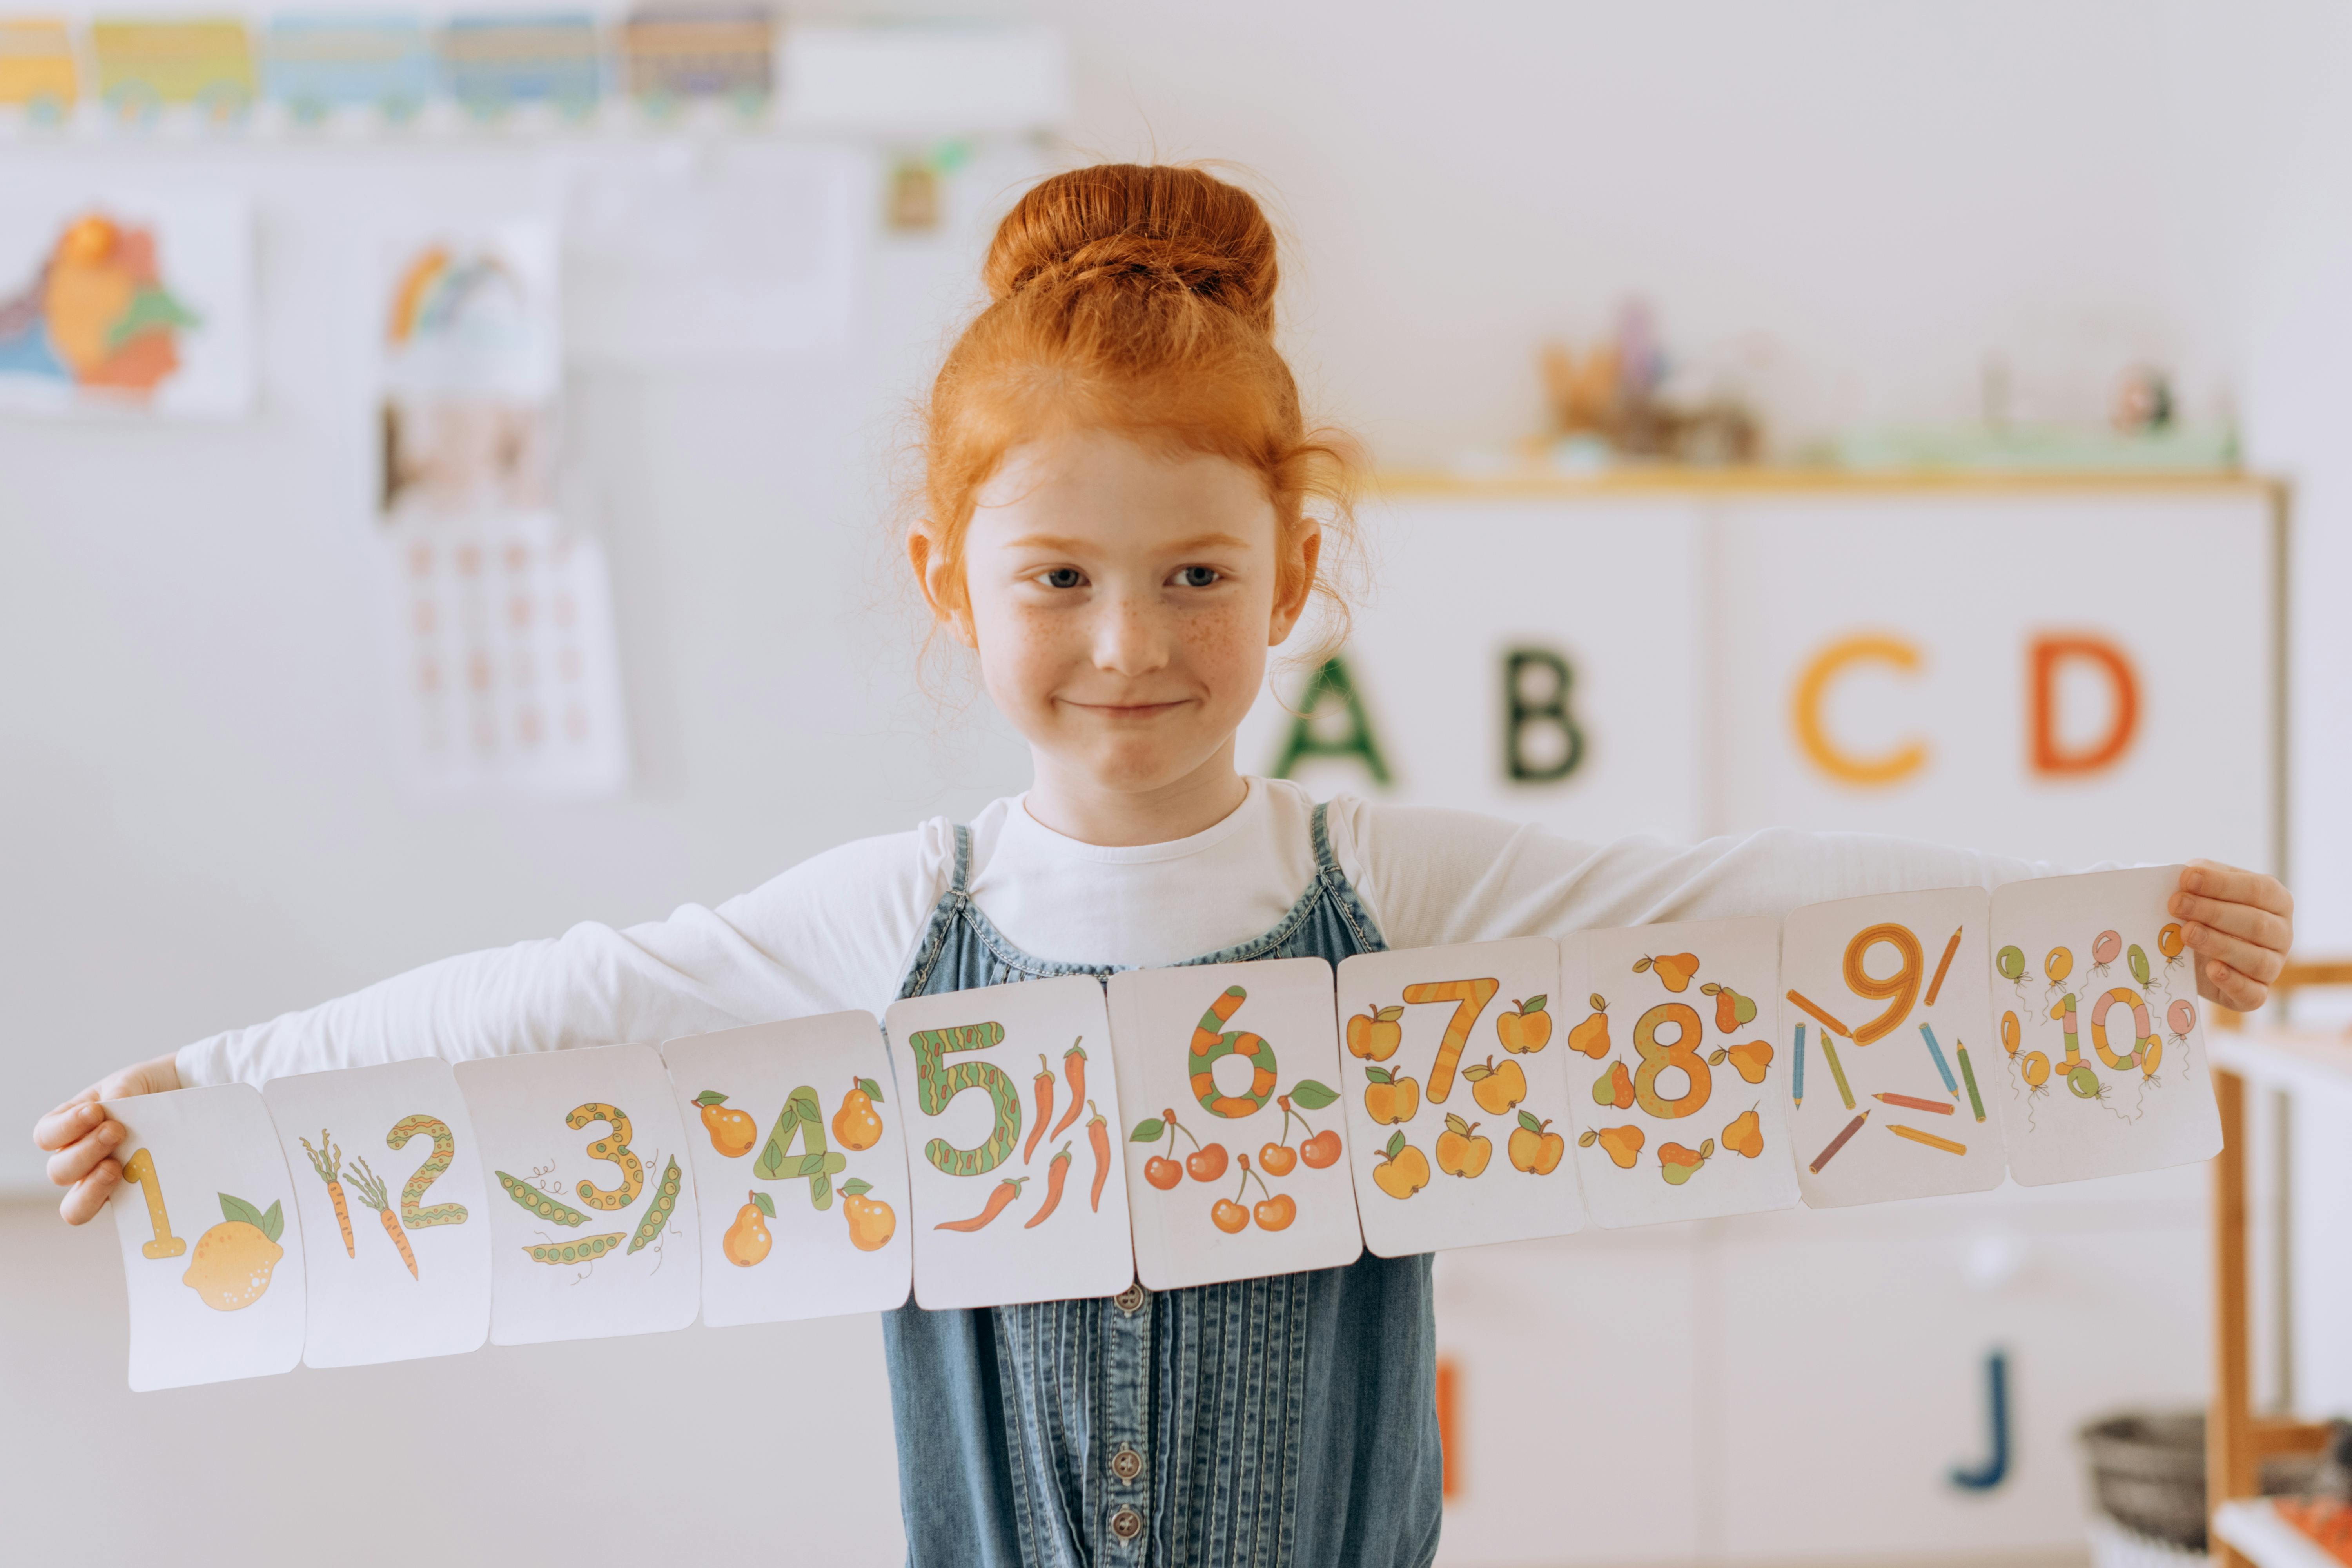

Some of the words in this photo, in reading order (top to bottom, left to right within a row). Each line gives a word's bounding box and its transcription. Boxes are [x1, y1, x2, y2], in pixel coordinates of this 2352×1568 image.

[1271, 654, 1395, 786] A
[1502, 648, 1584, 783] B
[1789, 634, 1927, 785] C
[2029, 636, 2140, 777] D
[1403, 978, 1499, 1104] 7
[1842, 922, 1924, 1046] 9
[2050, 987, 2150, 1075] 10
[909, 1021, 1021, 1176] 5
[1188, 985, 1277, 1118] 6
[1633, 1002, 1712, 1119] 8
[123, 1148, 186, 1259] 1
[386, 1114, 468, 1229] 2
[566, 1103, 644, 1210] 3
[753, 1086, 846, 1211] 4
[1947, 1349, 2010, 1492] J
